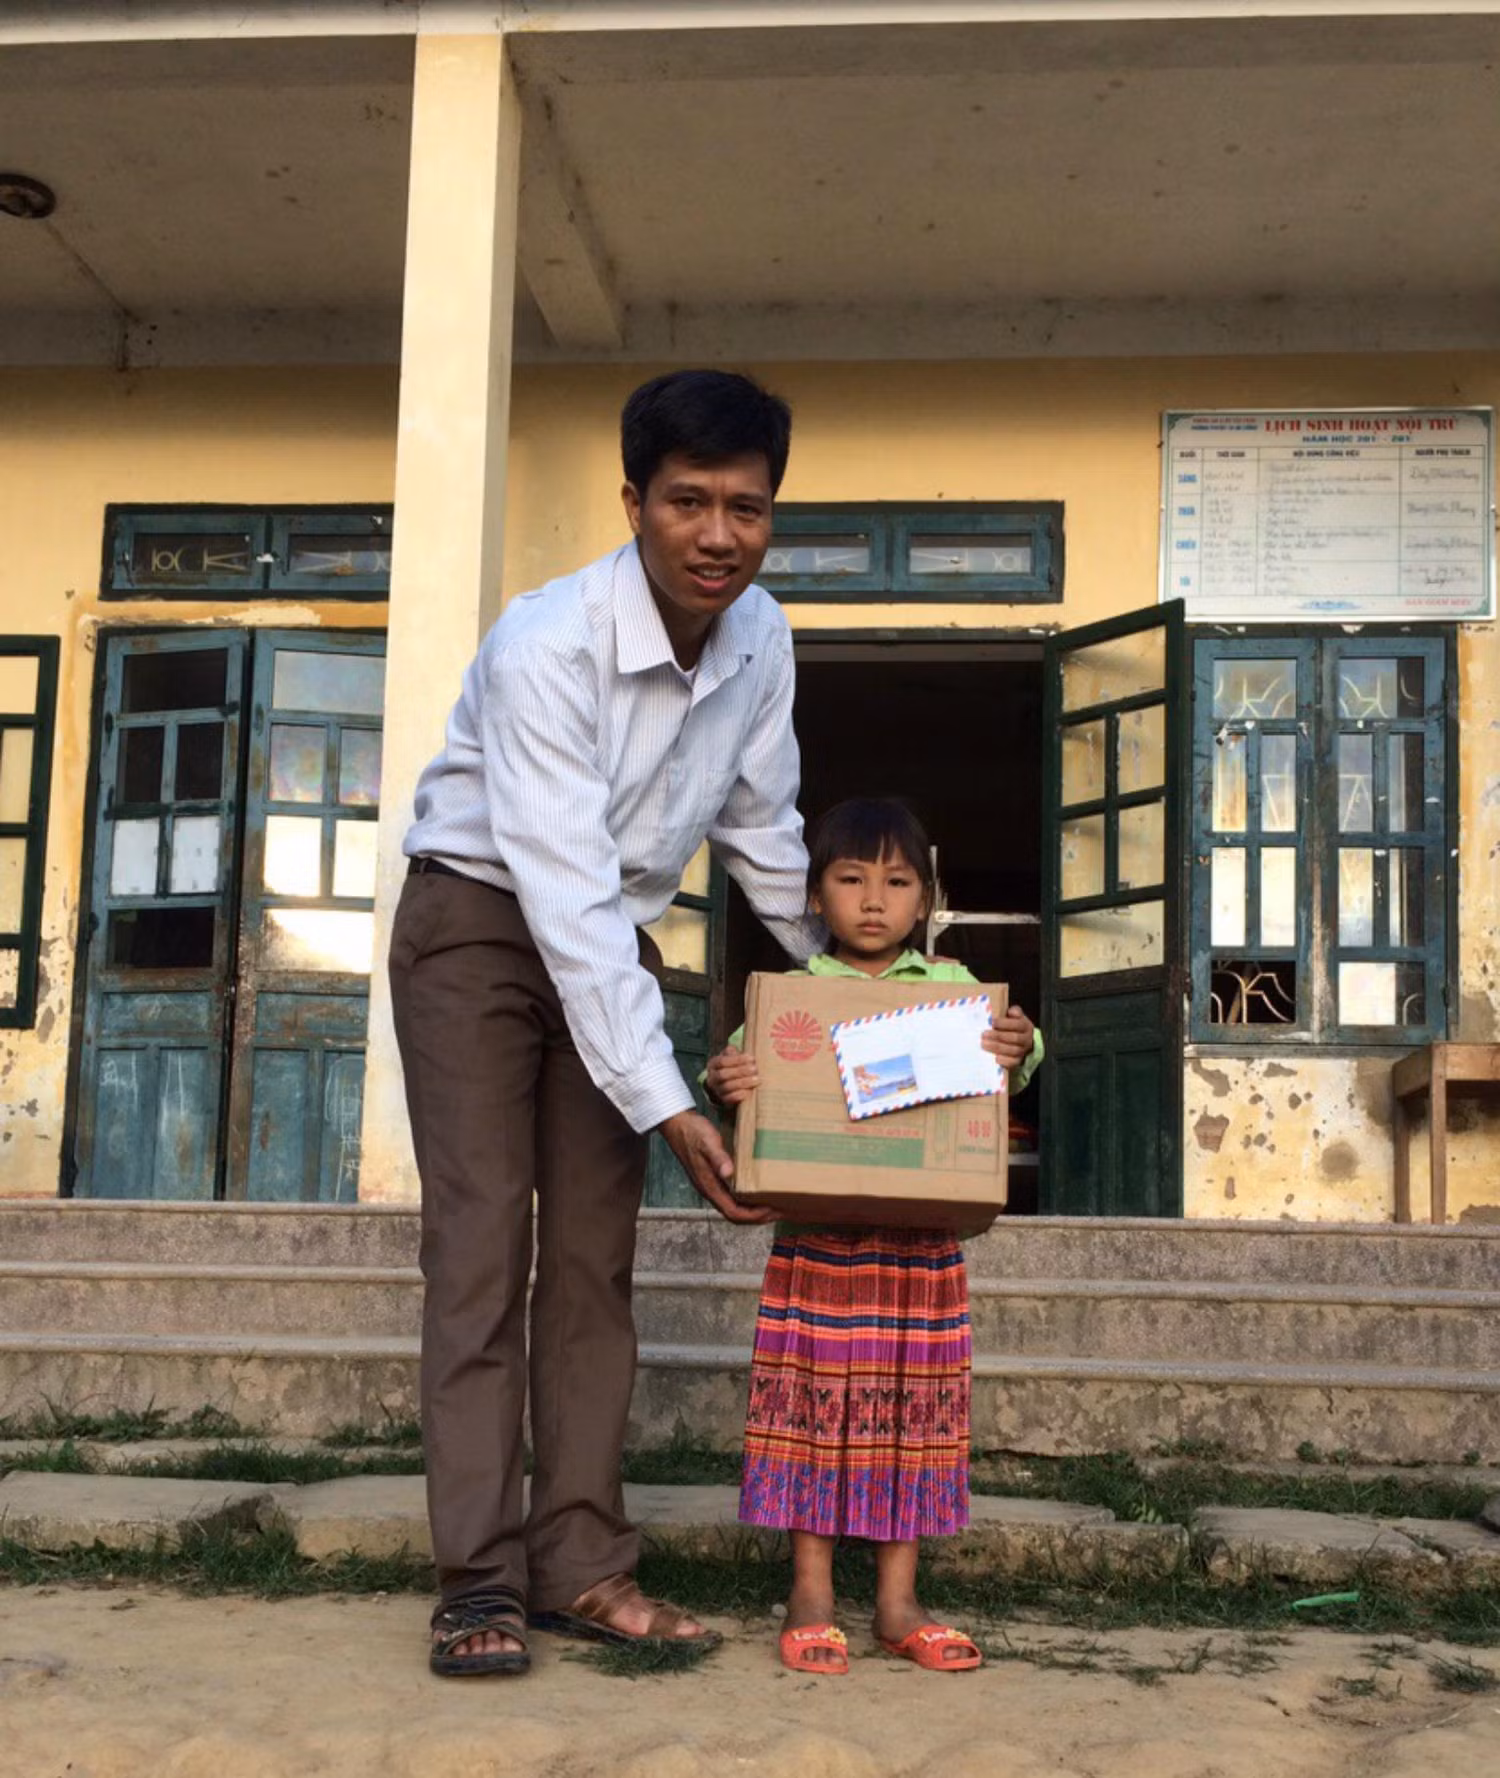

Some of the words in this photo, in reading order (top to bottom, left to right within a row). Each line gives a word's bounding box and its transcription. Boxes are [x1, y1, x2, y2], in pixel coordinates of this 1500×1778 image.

[1265, 420, 1301, 435] LỊCH
[1306, 419, 1343, 432] SINH
[1350, 418, 1391, 434] HOẠT
[1395, 416, 1422, 434] NỘI
[1428, 415, 1458, 431] TRÚ
[1331, 434, 1353, 444] HỌC
